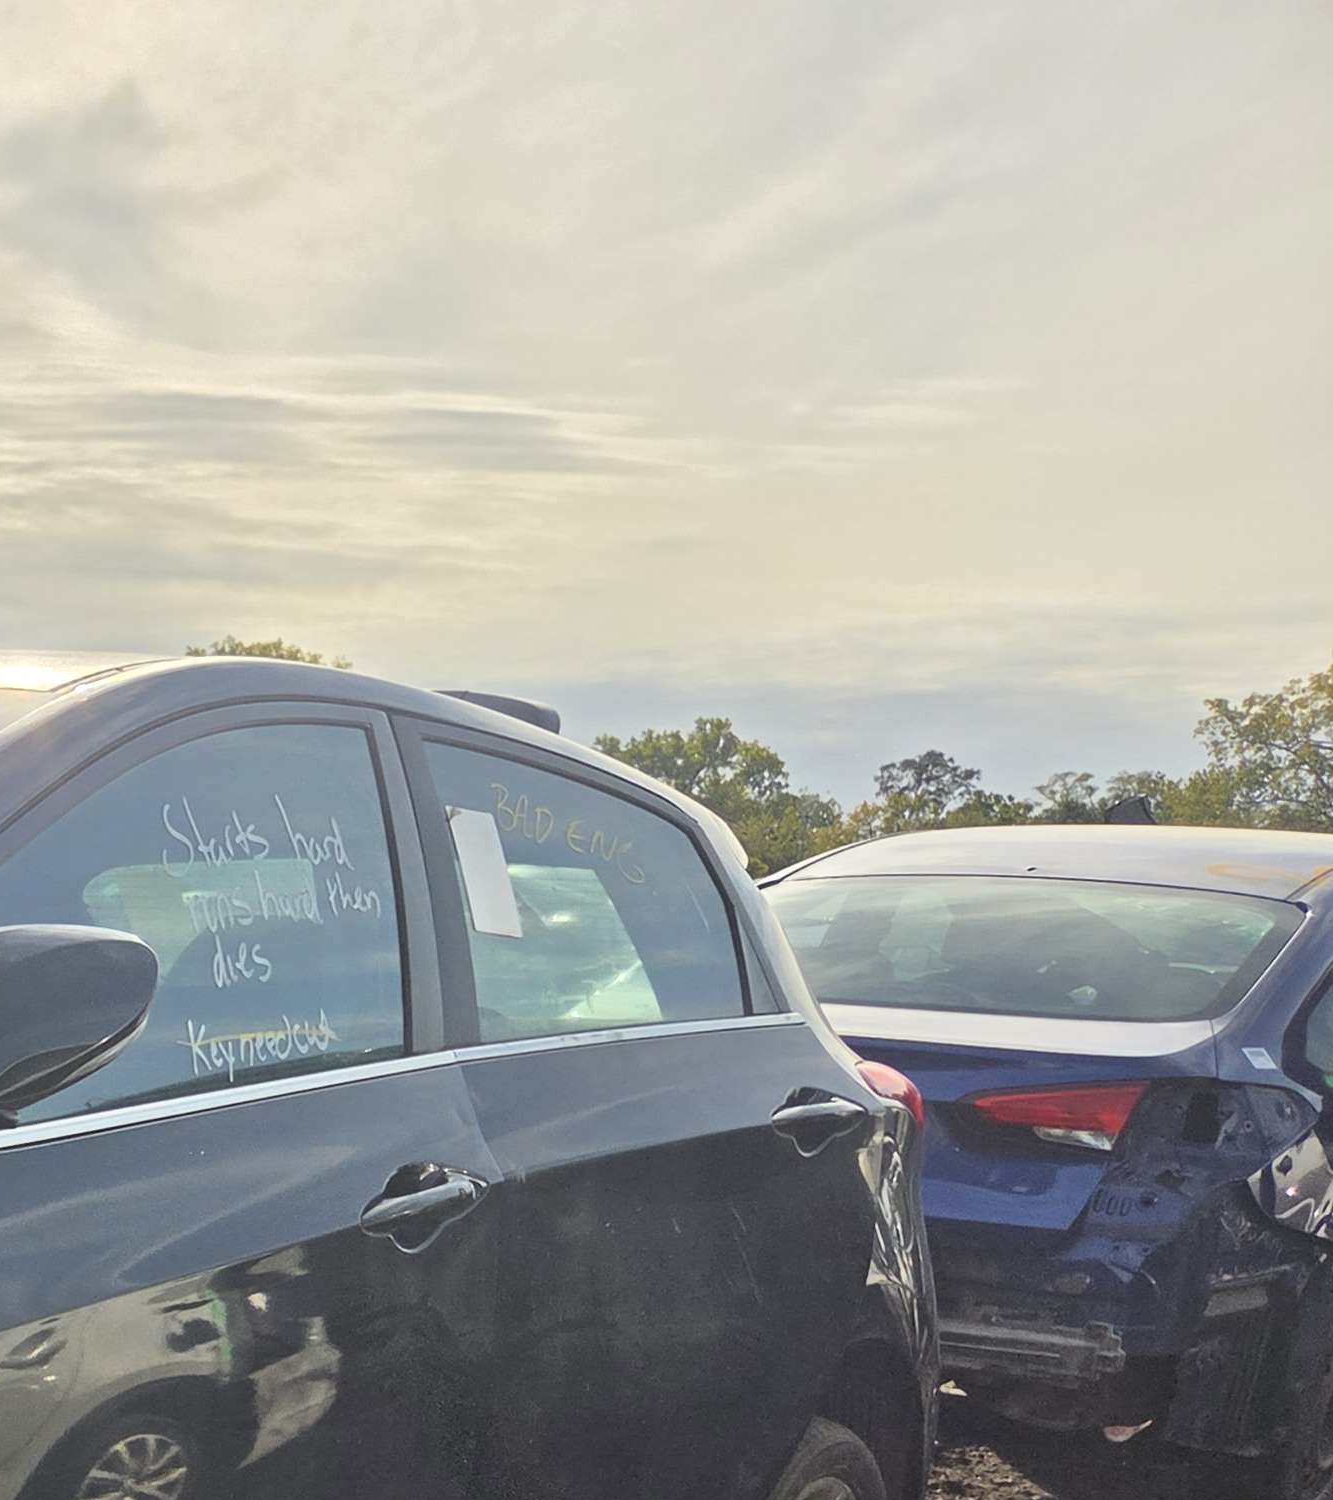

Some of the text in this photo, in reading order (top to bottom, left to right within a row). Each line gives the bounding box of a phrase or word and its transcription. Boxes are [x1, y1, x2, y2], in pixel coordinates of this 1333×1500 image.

[162, 793, 355, 878] Starts hard
[490, 782, 647, 885] BAD ENG
[255, 869, 324, 925] hard
[325, 871, 382, 919] then
[212, 934, 273, 988] dies
